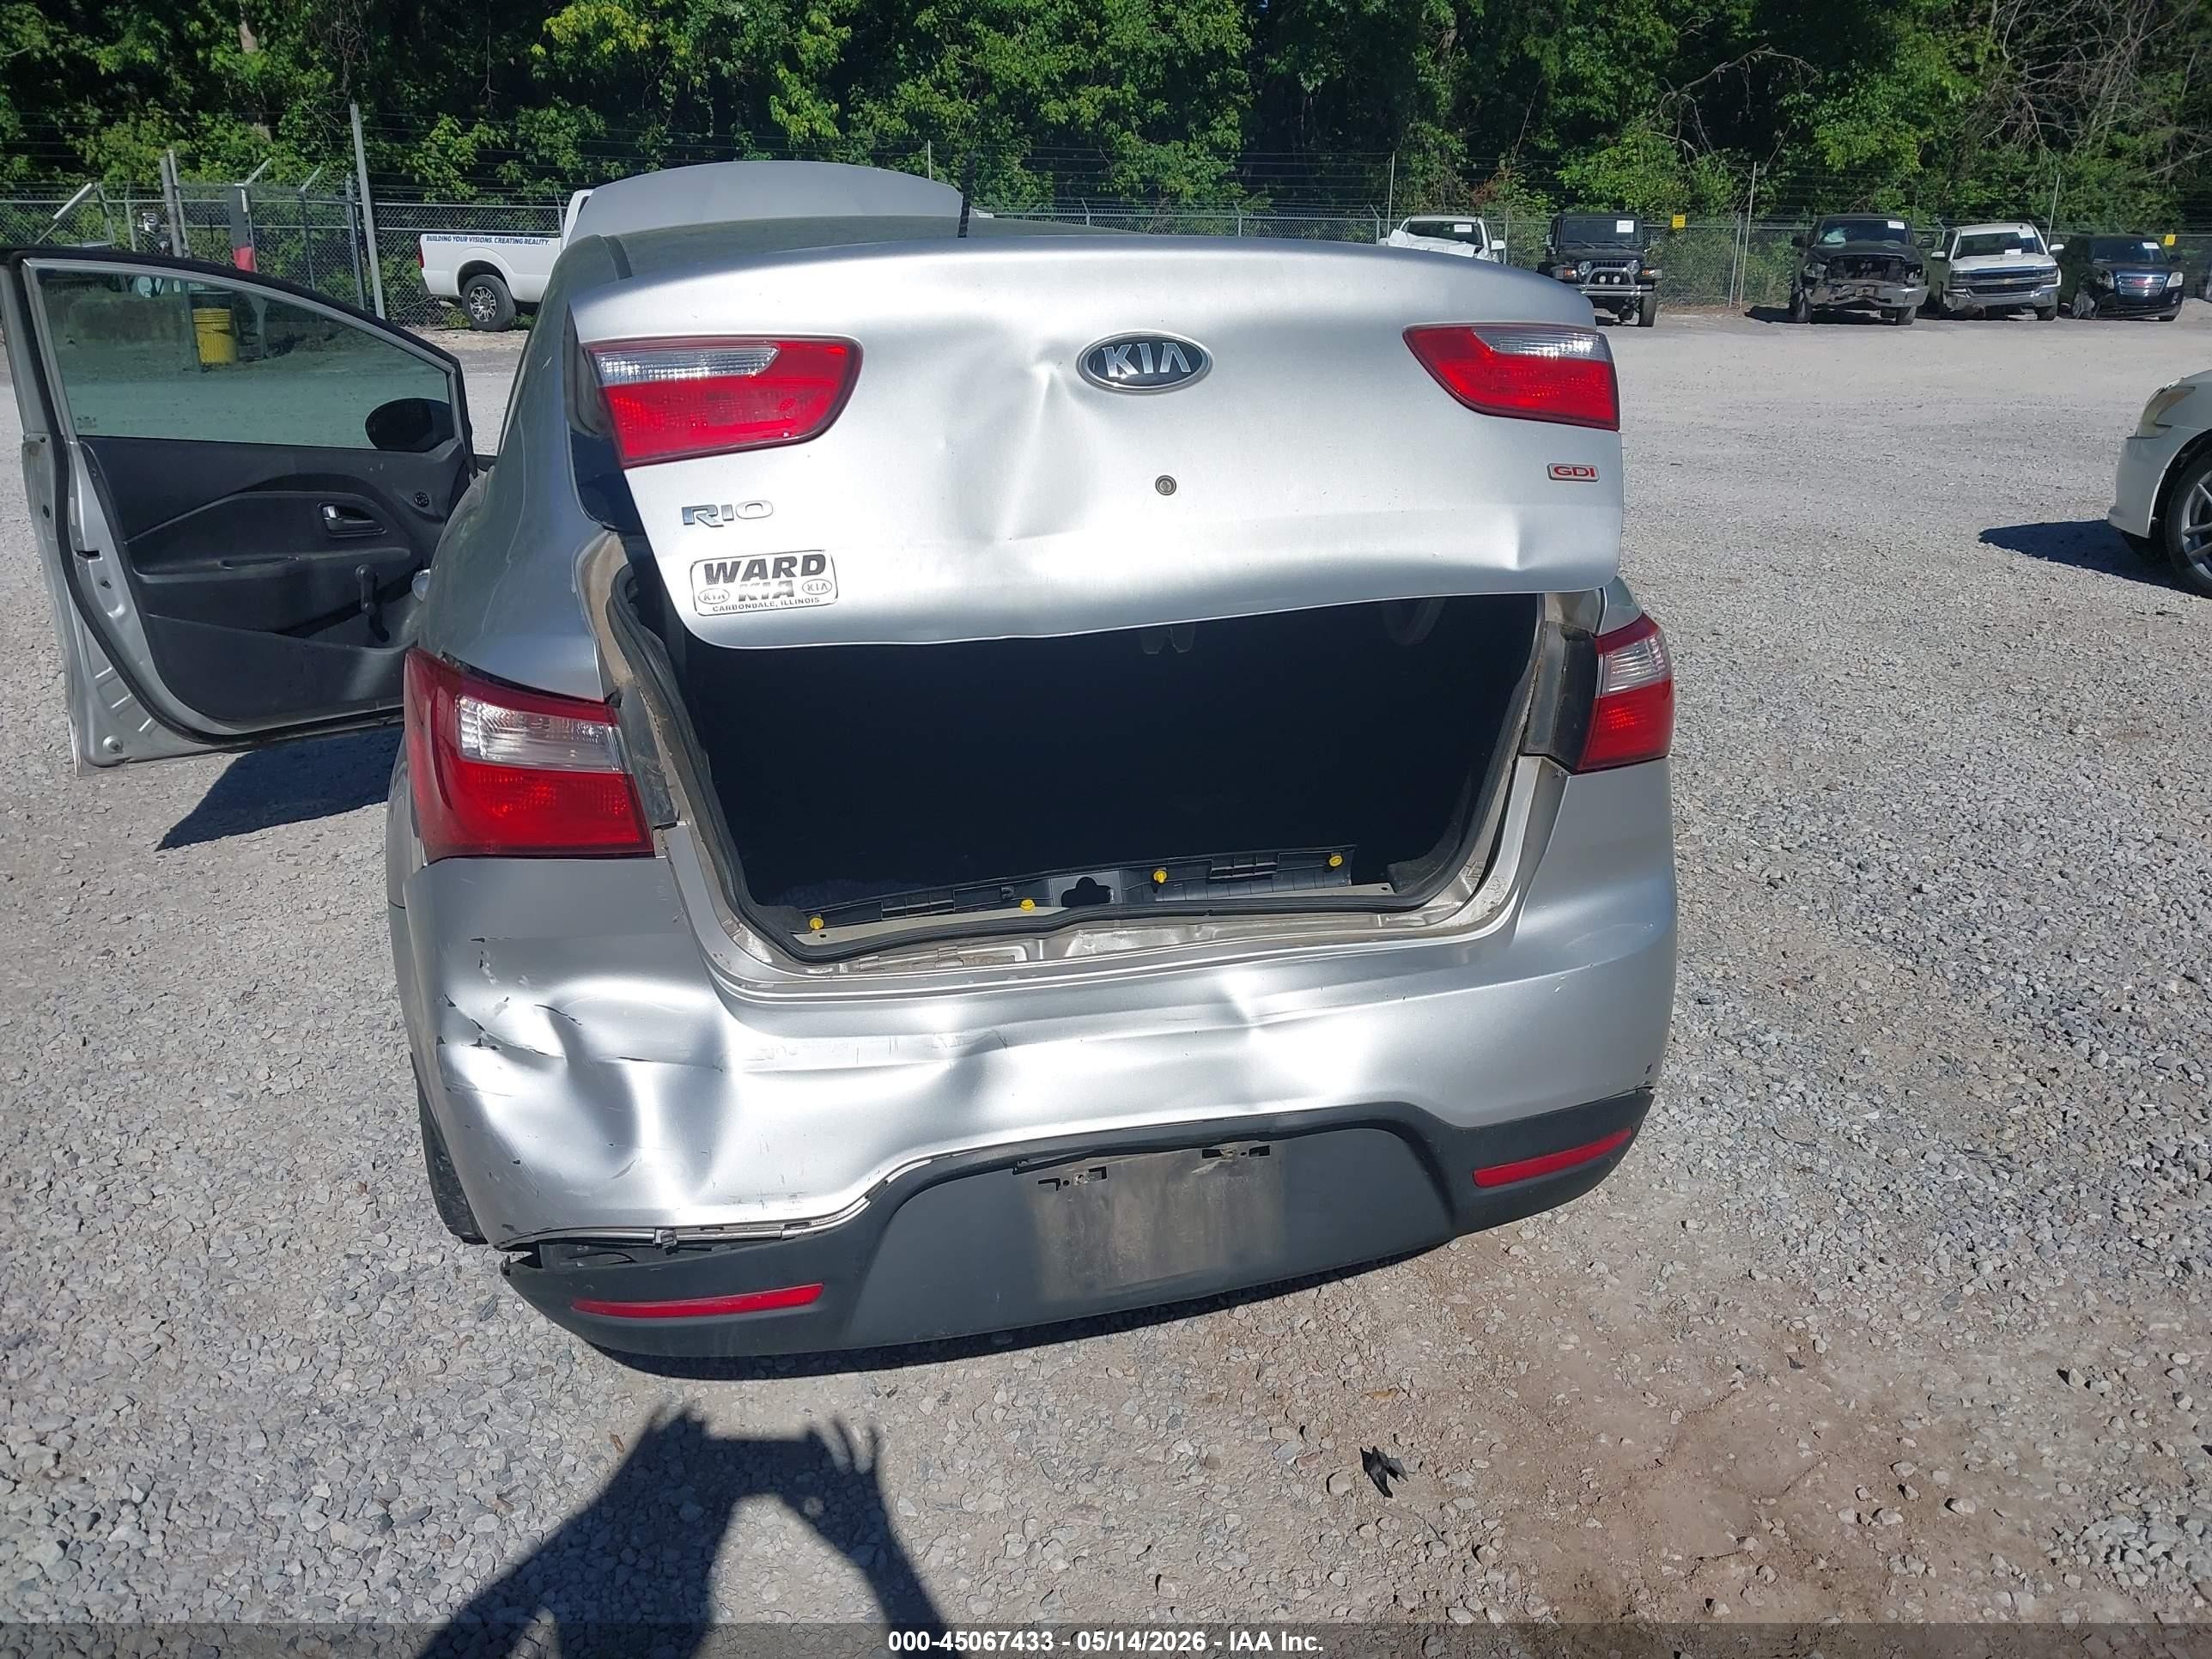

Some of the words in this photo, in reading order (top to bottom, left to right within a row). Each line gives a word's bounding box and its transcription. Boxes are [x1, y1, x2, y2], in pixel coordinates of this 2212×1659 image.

[1102, 343, 1192, 378] KIA
[1553, 465, 1595, 477] GDI
[681, 500, 774, 528] RIO
[704, 554, 826, 586] WARD
[738, 580, 795, 602] KIA
[806, 582, 829, 592] KIA
[712, 601, 779, 612] CARBONDALE,
[780, 597, 820, 606] ILLINOIS
